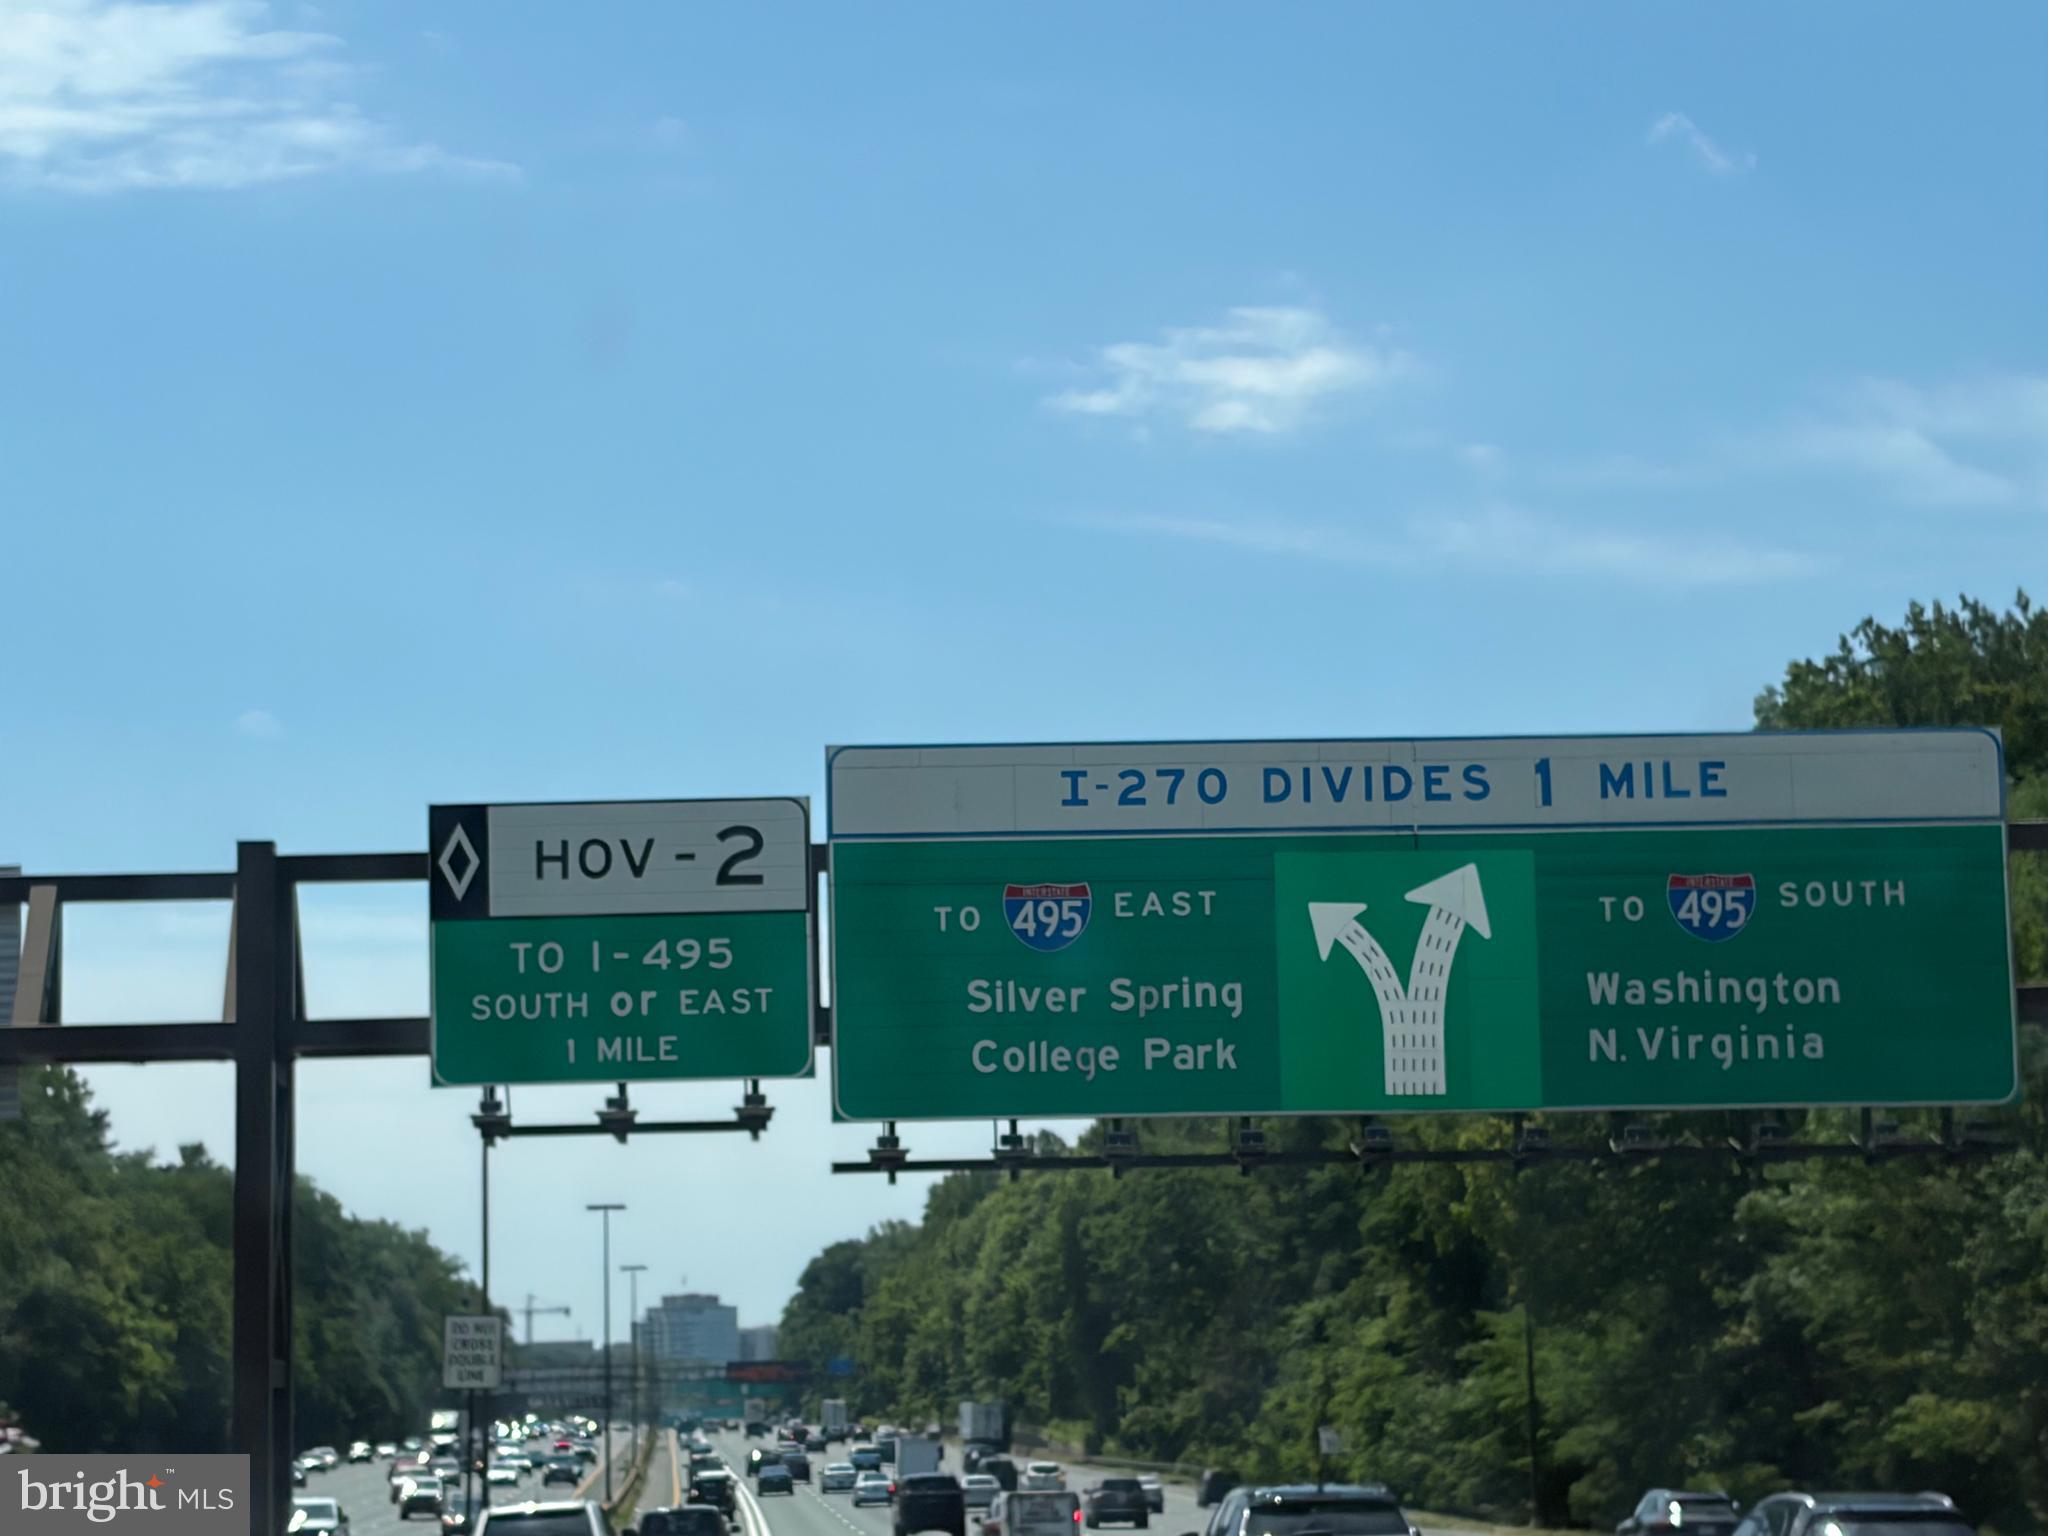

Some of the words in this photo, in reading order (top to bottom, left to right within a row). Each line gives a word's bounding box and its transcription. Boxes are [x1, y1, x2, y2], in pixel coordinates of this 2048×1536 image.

[1060, 767, 1228, 807] I-270
[1263, 763, 1490, 804] DIVIDES
[1534, 757, 1553, 807] 1
[1600, 761, 1727, 799] MILE
[934, 906, 981, 932] TO
[1012, 900, 1083, 938] 495
[1114, 891, 1216, 918] EAST
[1599, 896, 1645, 922] TO
[1677, 889, 1747, 929] 495
[1779, 880, 1906, 907] SOUTH
[510, 942, 564, 973] TO
[471, 992, 588, 1020] SOUTH
[610, 991, 657, 1017] or
[680, 988, 773, 1015] EAST
[967, 979, 1087, 1013] Silver
[1110, 976, 1243, 1019] Spring
[1587, 969, 1841, 1014] Washington
[566, 1038, 576, 1064] 1
[598, 1035, 678, 1062] MILE
[972, 1040, 1120, 1081] College
[1144, 1037, 1237, 1070] Park
